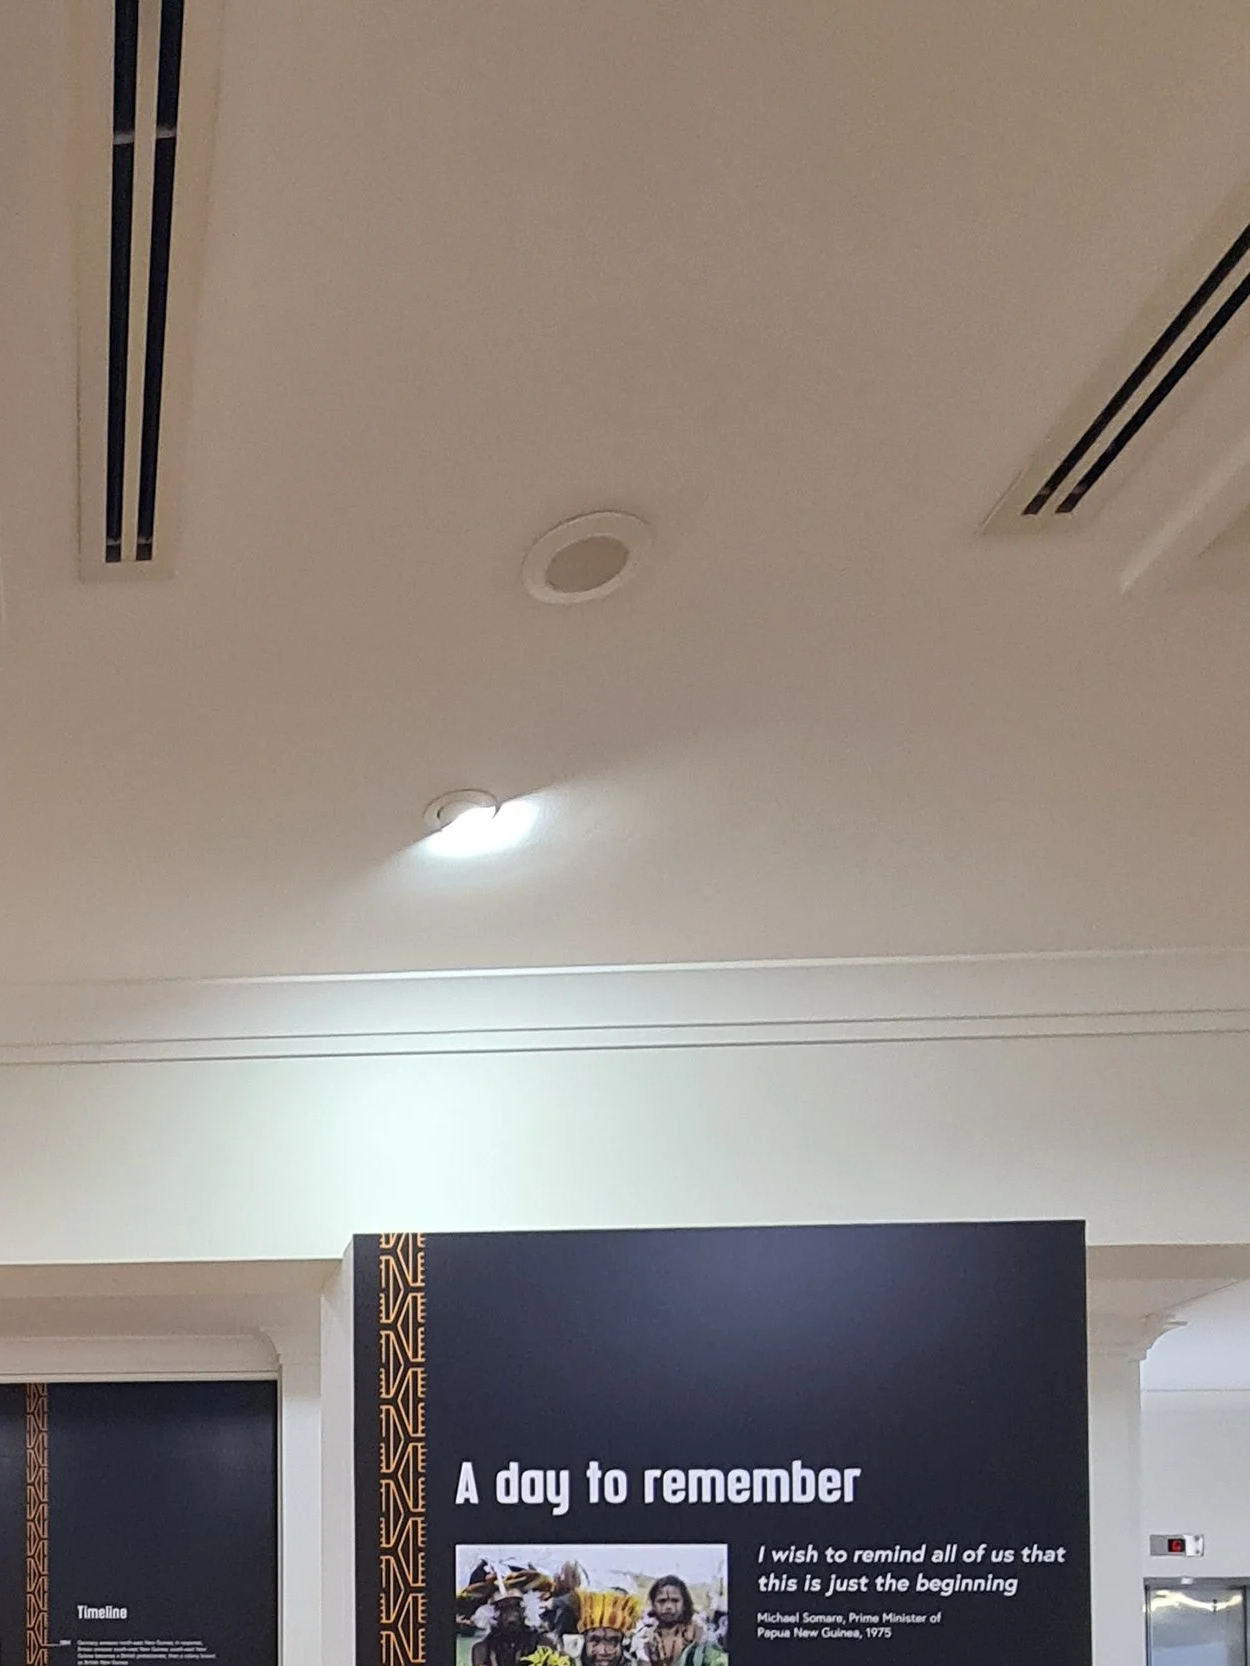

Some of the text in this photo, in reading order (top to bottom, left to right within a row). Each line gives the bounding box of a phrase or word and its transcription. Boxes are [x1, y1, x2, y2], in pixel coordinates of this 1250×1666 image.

[455, 1459, 861, 1515] A day to remember
[758, 1544, 1066, 1563] I wish to remind all of us that
[758, 1573, 1018, 1597] this is just the beginning
[77, 1605, 127, 1619] Timeline
[757, 1612, 941, 1625] Michael Somare, Prime Minister of
[757, 1627, 892, 1640] Papua New Guinea, 1975
